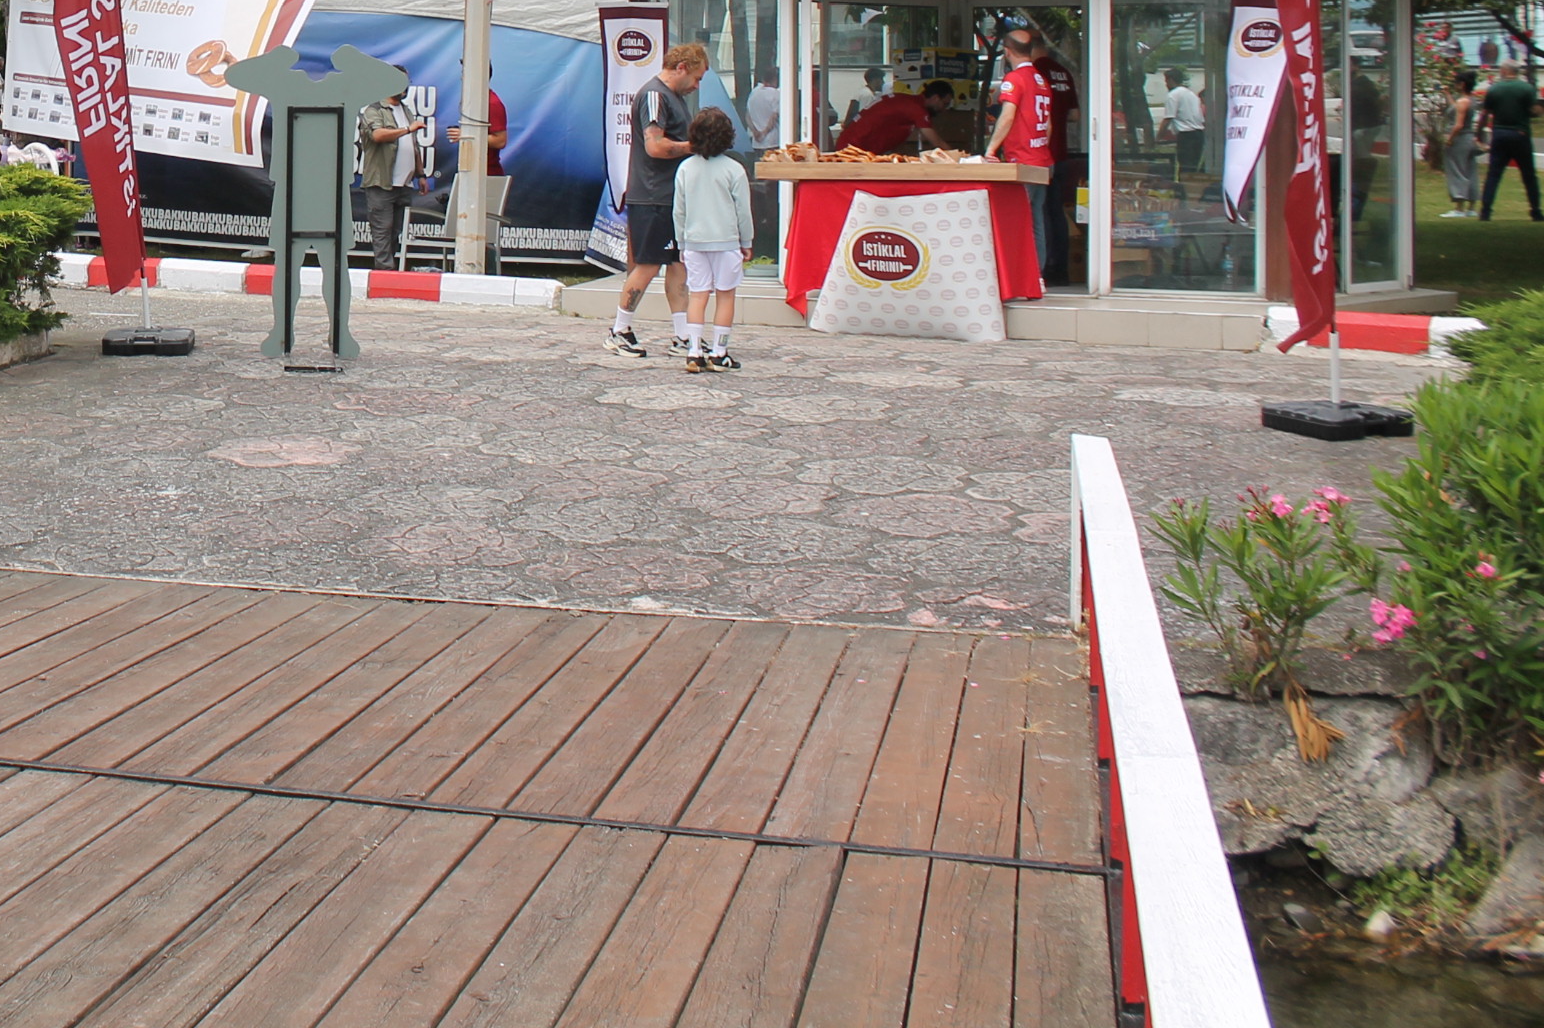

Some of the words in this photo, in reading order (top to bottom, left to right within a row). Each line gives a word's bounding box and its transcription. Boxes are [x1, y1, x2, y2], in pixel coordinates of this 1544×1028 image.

[144, 49, 181, 70] FIRINI
[862, 240, 907, 258] İSTİKLAL
[871, 259, 900, 272] FIRINI
